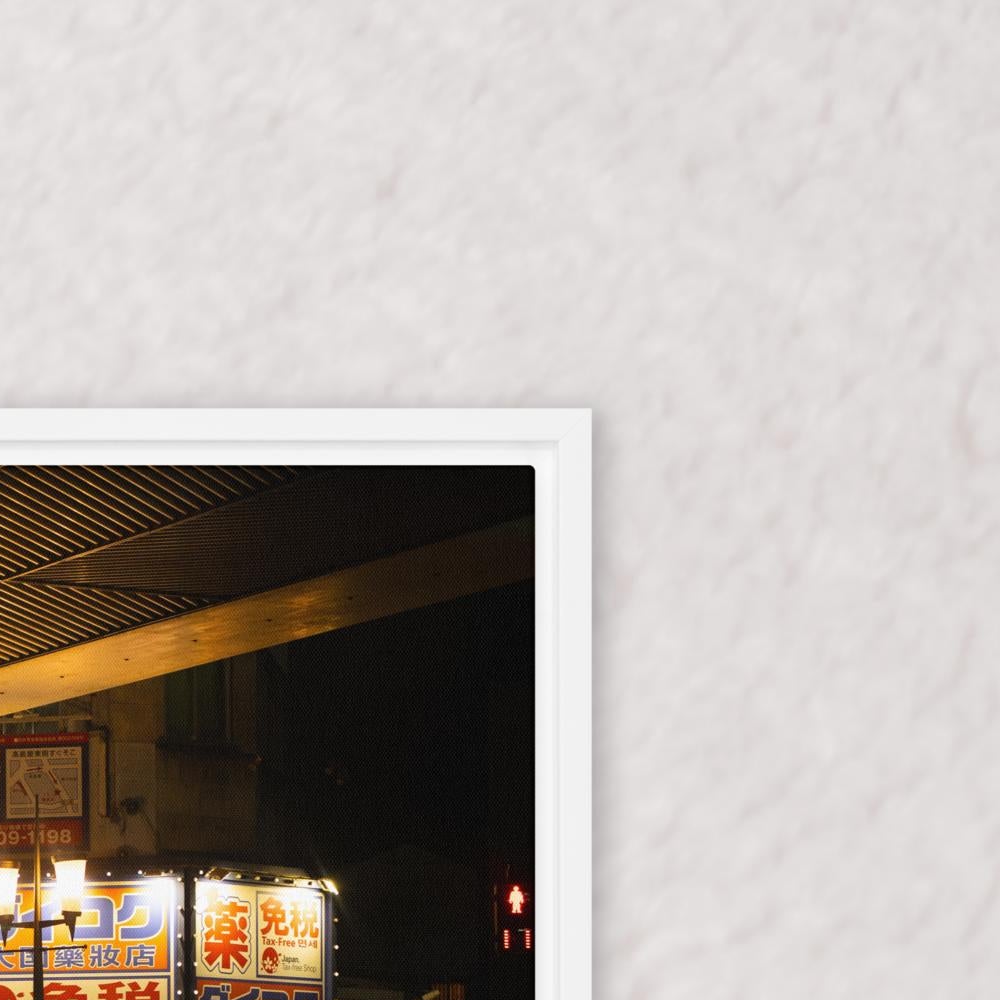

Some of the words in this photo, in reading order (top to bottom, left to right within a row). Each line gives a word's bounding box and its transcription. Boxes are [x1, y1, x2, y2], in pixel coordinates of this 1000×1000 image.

[260, 896, 320, 938] 免税
[203, 900, 249, 970] 薬
[262, 936, 296, 948] Tax-Free
[303, 964, 317, 973] Shop
